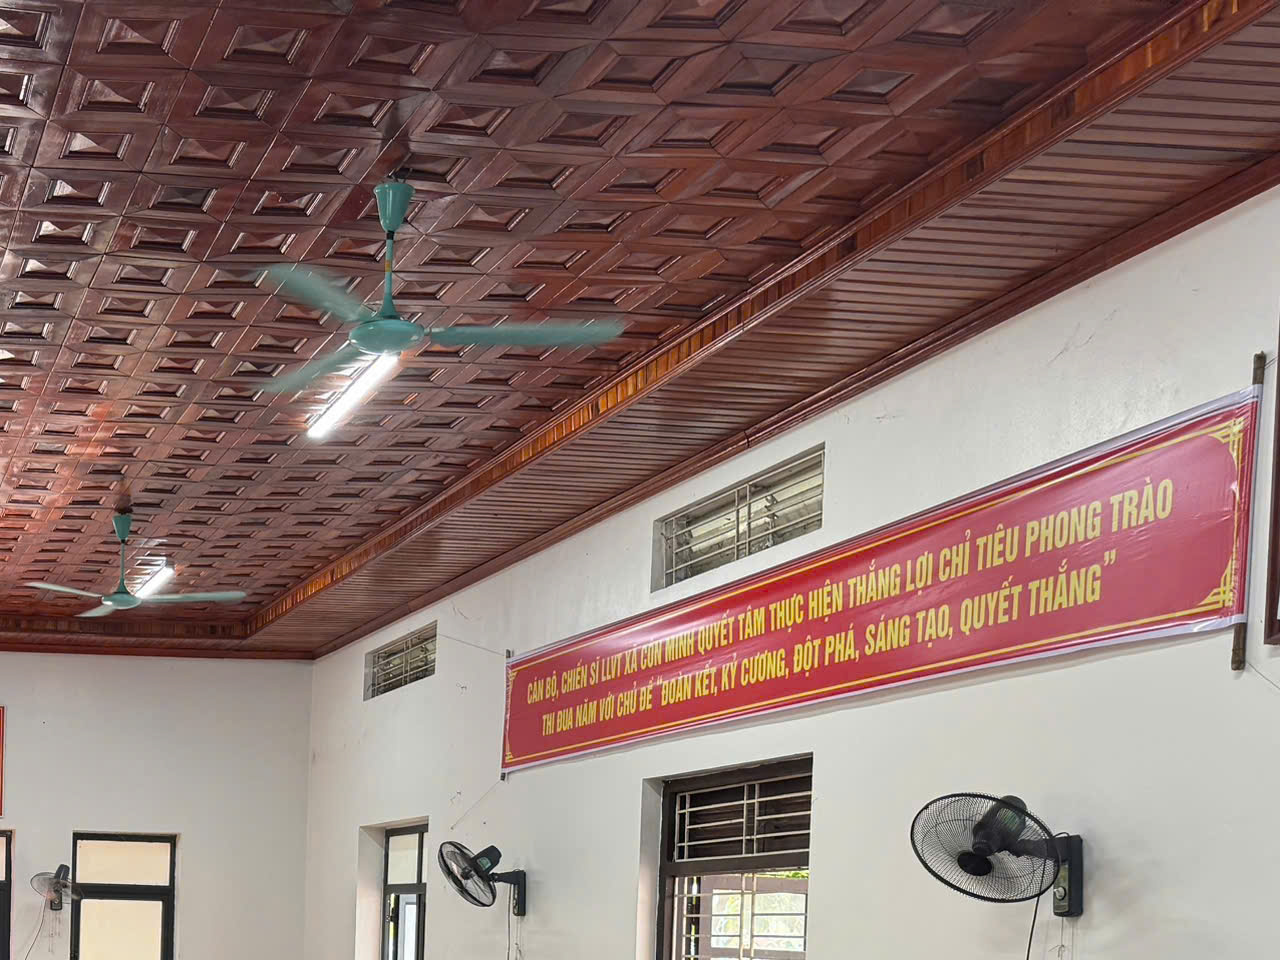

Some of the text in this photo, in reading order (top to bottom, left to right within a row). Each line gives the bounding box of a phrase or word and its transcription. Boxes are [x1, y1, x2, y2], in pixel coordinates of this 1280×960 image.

[527, 476, 1173, 705] CÁN BỘ, CHIẾN SĨ LLVT XÃ CÔN MINH QUYẾT TÂM THỰC HIỆN THẮNG LỢI CHỈ TIÊU PHONG TRÀO
[542, 711, 555, 737] THI
[556, 706, 573, 733] ĐUA
[575, 697, 597, 728] NĂM
[599, 692, 615, 722] VỚI
[616, 681, 637, 718] CHỦ
[639, 676, 653, 712] ĐỀ
[694, 659, 718, 697] KẾT,
[721, 652, 738, 692] KỶ
[740, 647, 790, 687] CƯƠNG,
[793, 634, 821, 677] ĐỘT
[824, 623, 860, 666] PHÁ,
[864, 613, 910, 656] SÁNG
[916, 603, 953, 648] TẠO,
[959, 575, 1022, 636] QUYẾT
